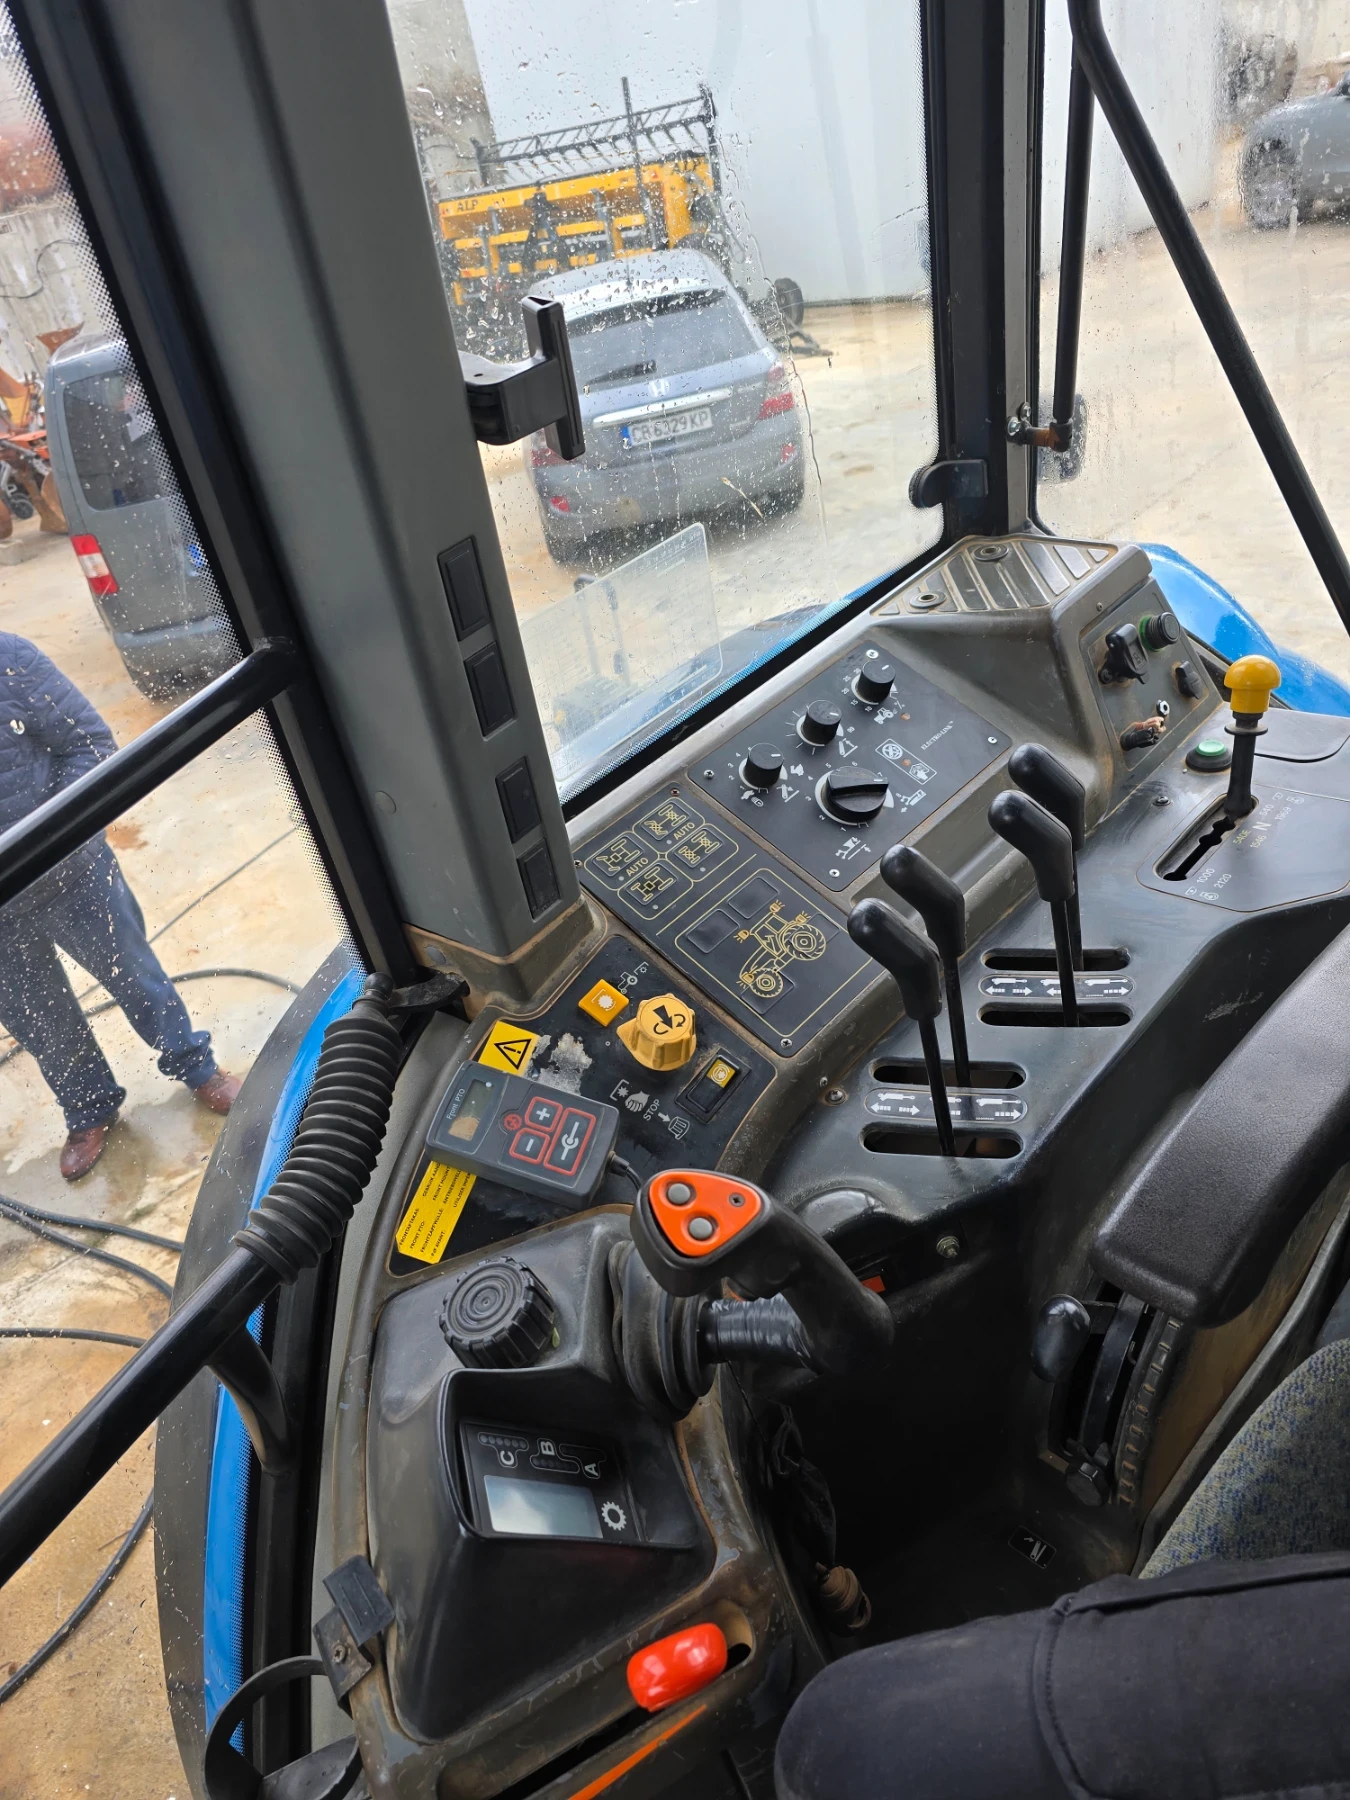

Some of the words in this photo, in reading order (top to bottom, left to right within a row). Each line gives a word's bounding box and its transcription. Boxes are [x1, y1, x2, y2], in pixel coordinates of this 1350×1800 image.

[457, 199, 479, 212] ALP
[673, 822, 695, 840] AUTO
[1252, 821, 1272, 831] N
[626, 857, 648, 877] AUTO
[1196, 868, 1215, 884] 1000
[1213, 873, 1232, 889] 2120
[455, 1088, 465, 1102] PTO
[643, 1098, 660, 1121] STOP
[500, 1450, 515, 1466] C
[540, 1441, 555, 1456] B
[584, 1463, 599, 1476] A
